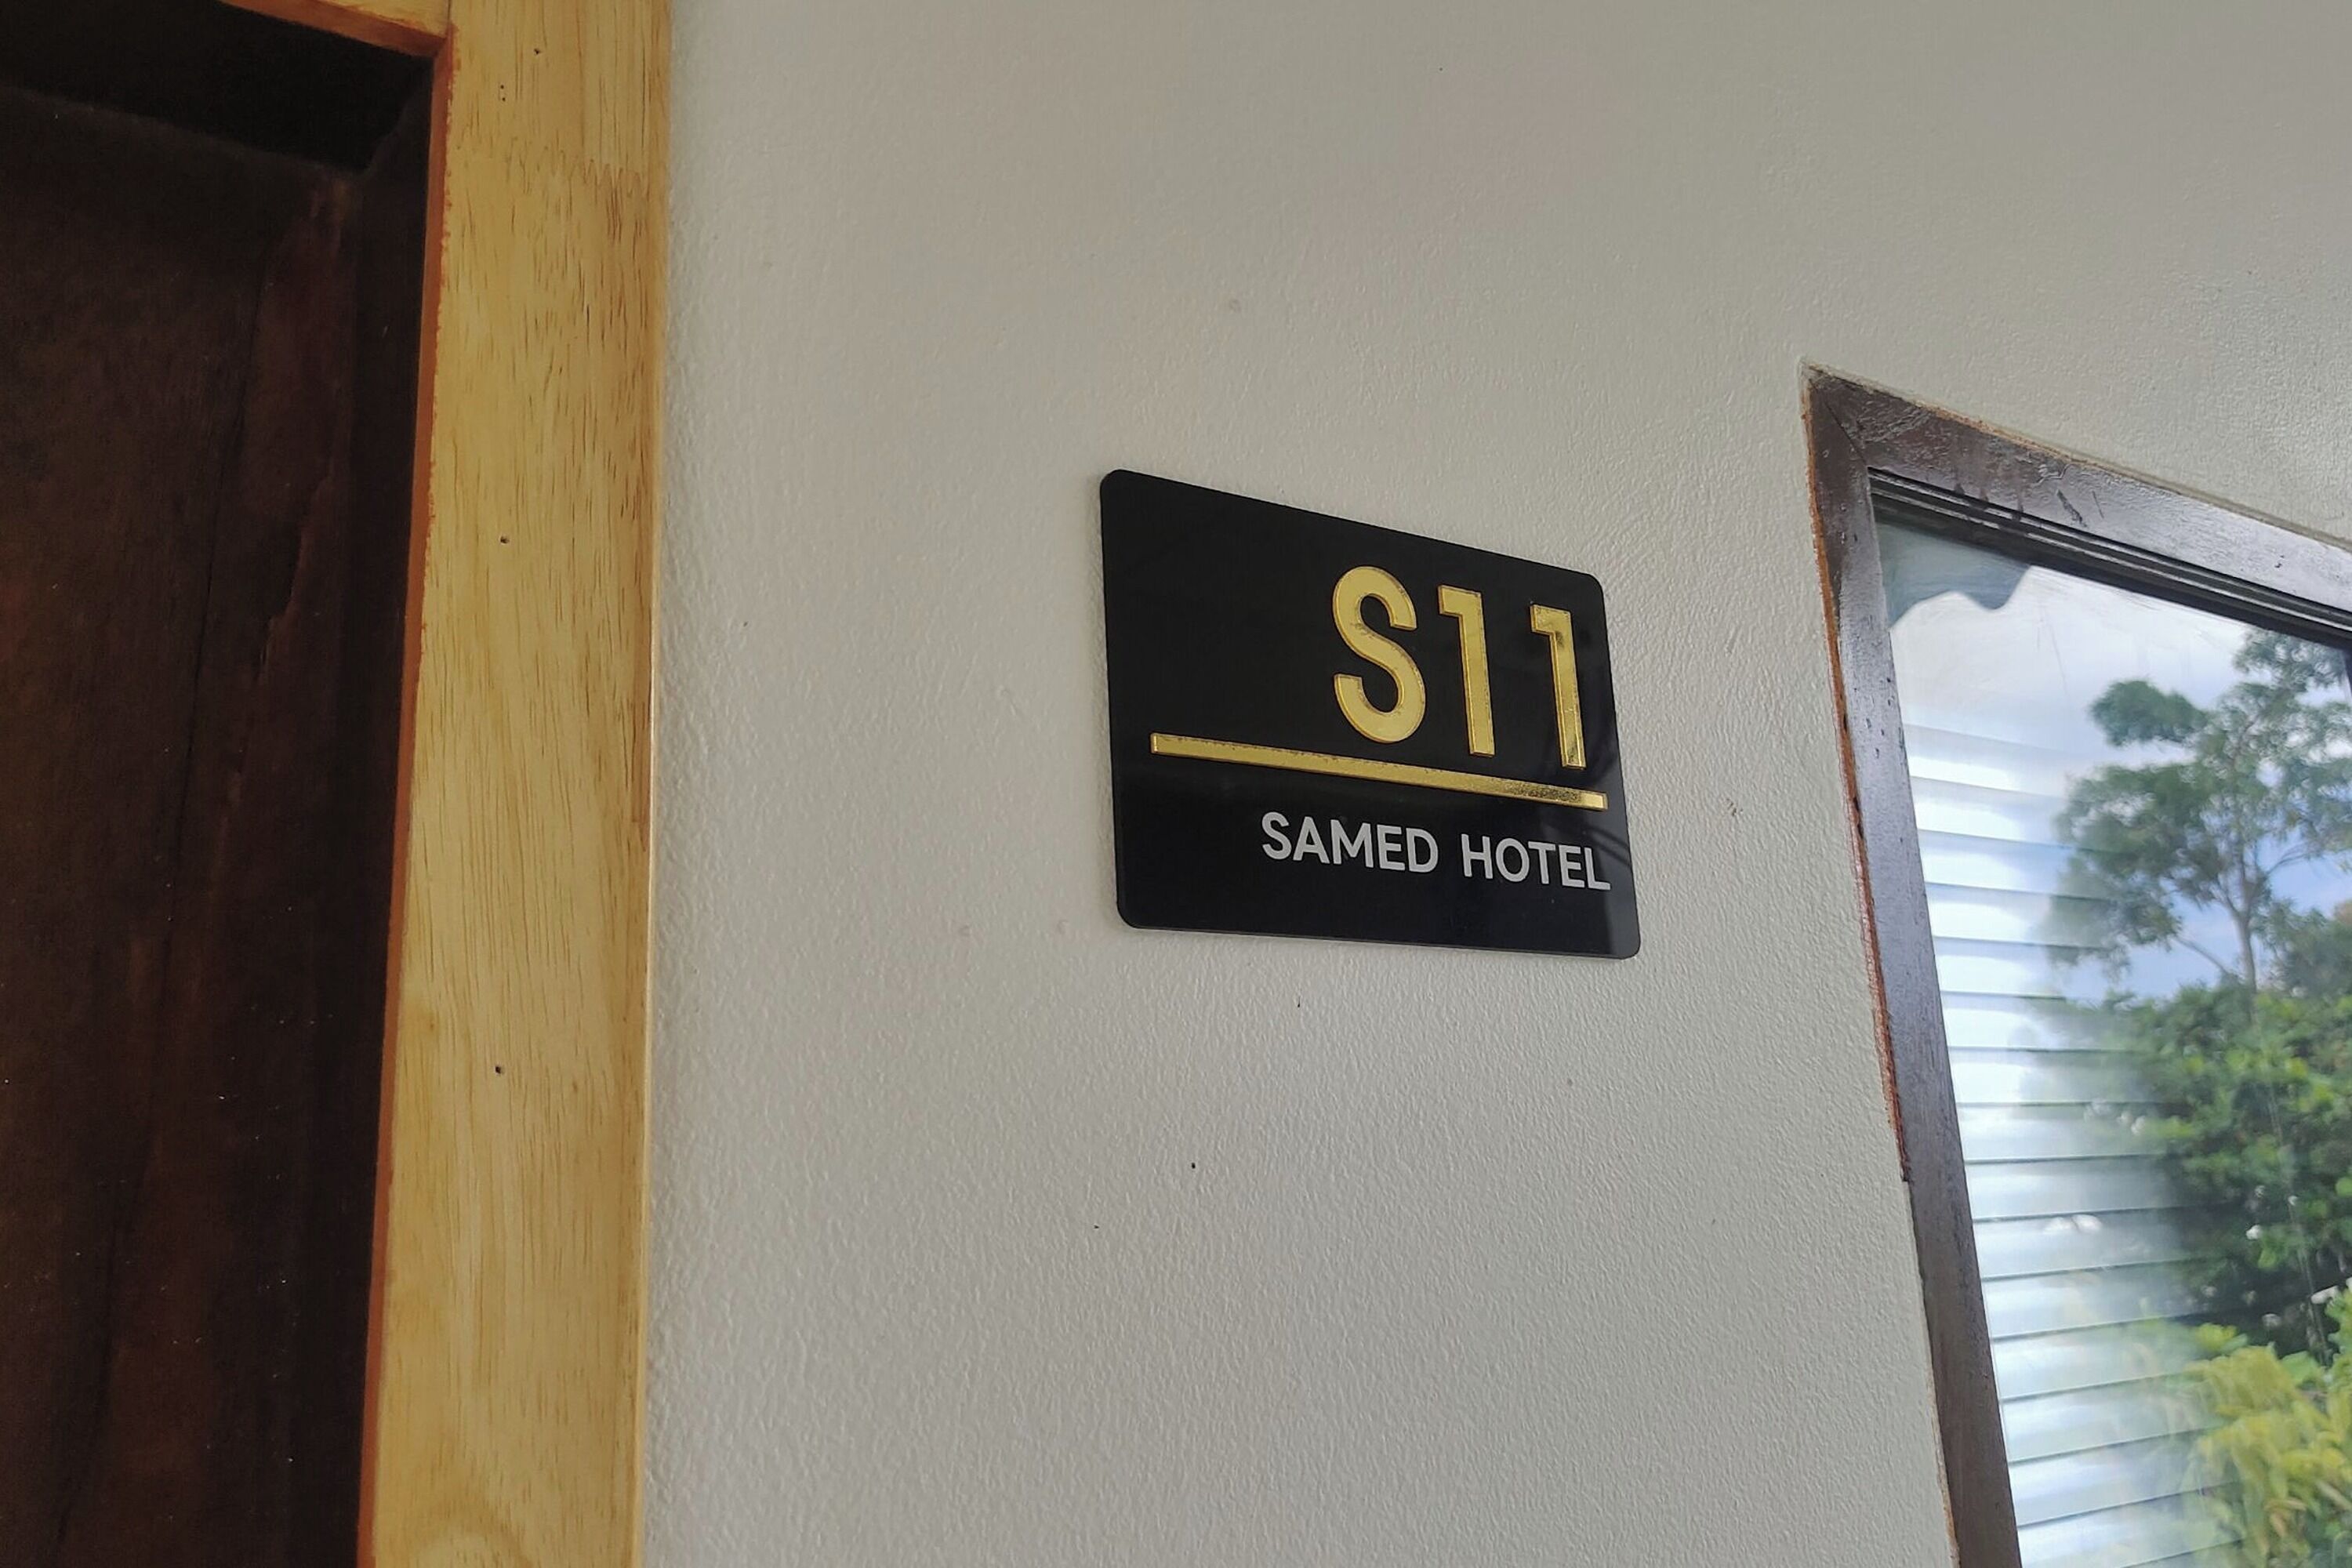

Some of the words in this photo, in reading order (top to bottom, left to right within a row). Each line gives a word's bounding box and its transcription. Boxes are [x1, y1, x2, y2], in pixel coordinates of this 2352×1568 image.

[1332, 565, 1587, 769] S11
[1261, 811, 1439, 873] SAMED
[1461, 833, 1611, 891] HOTEL
